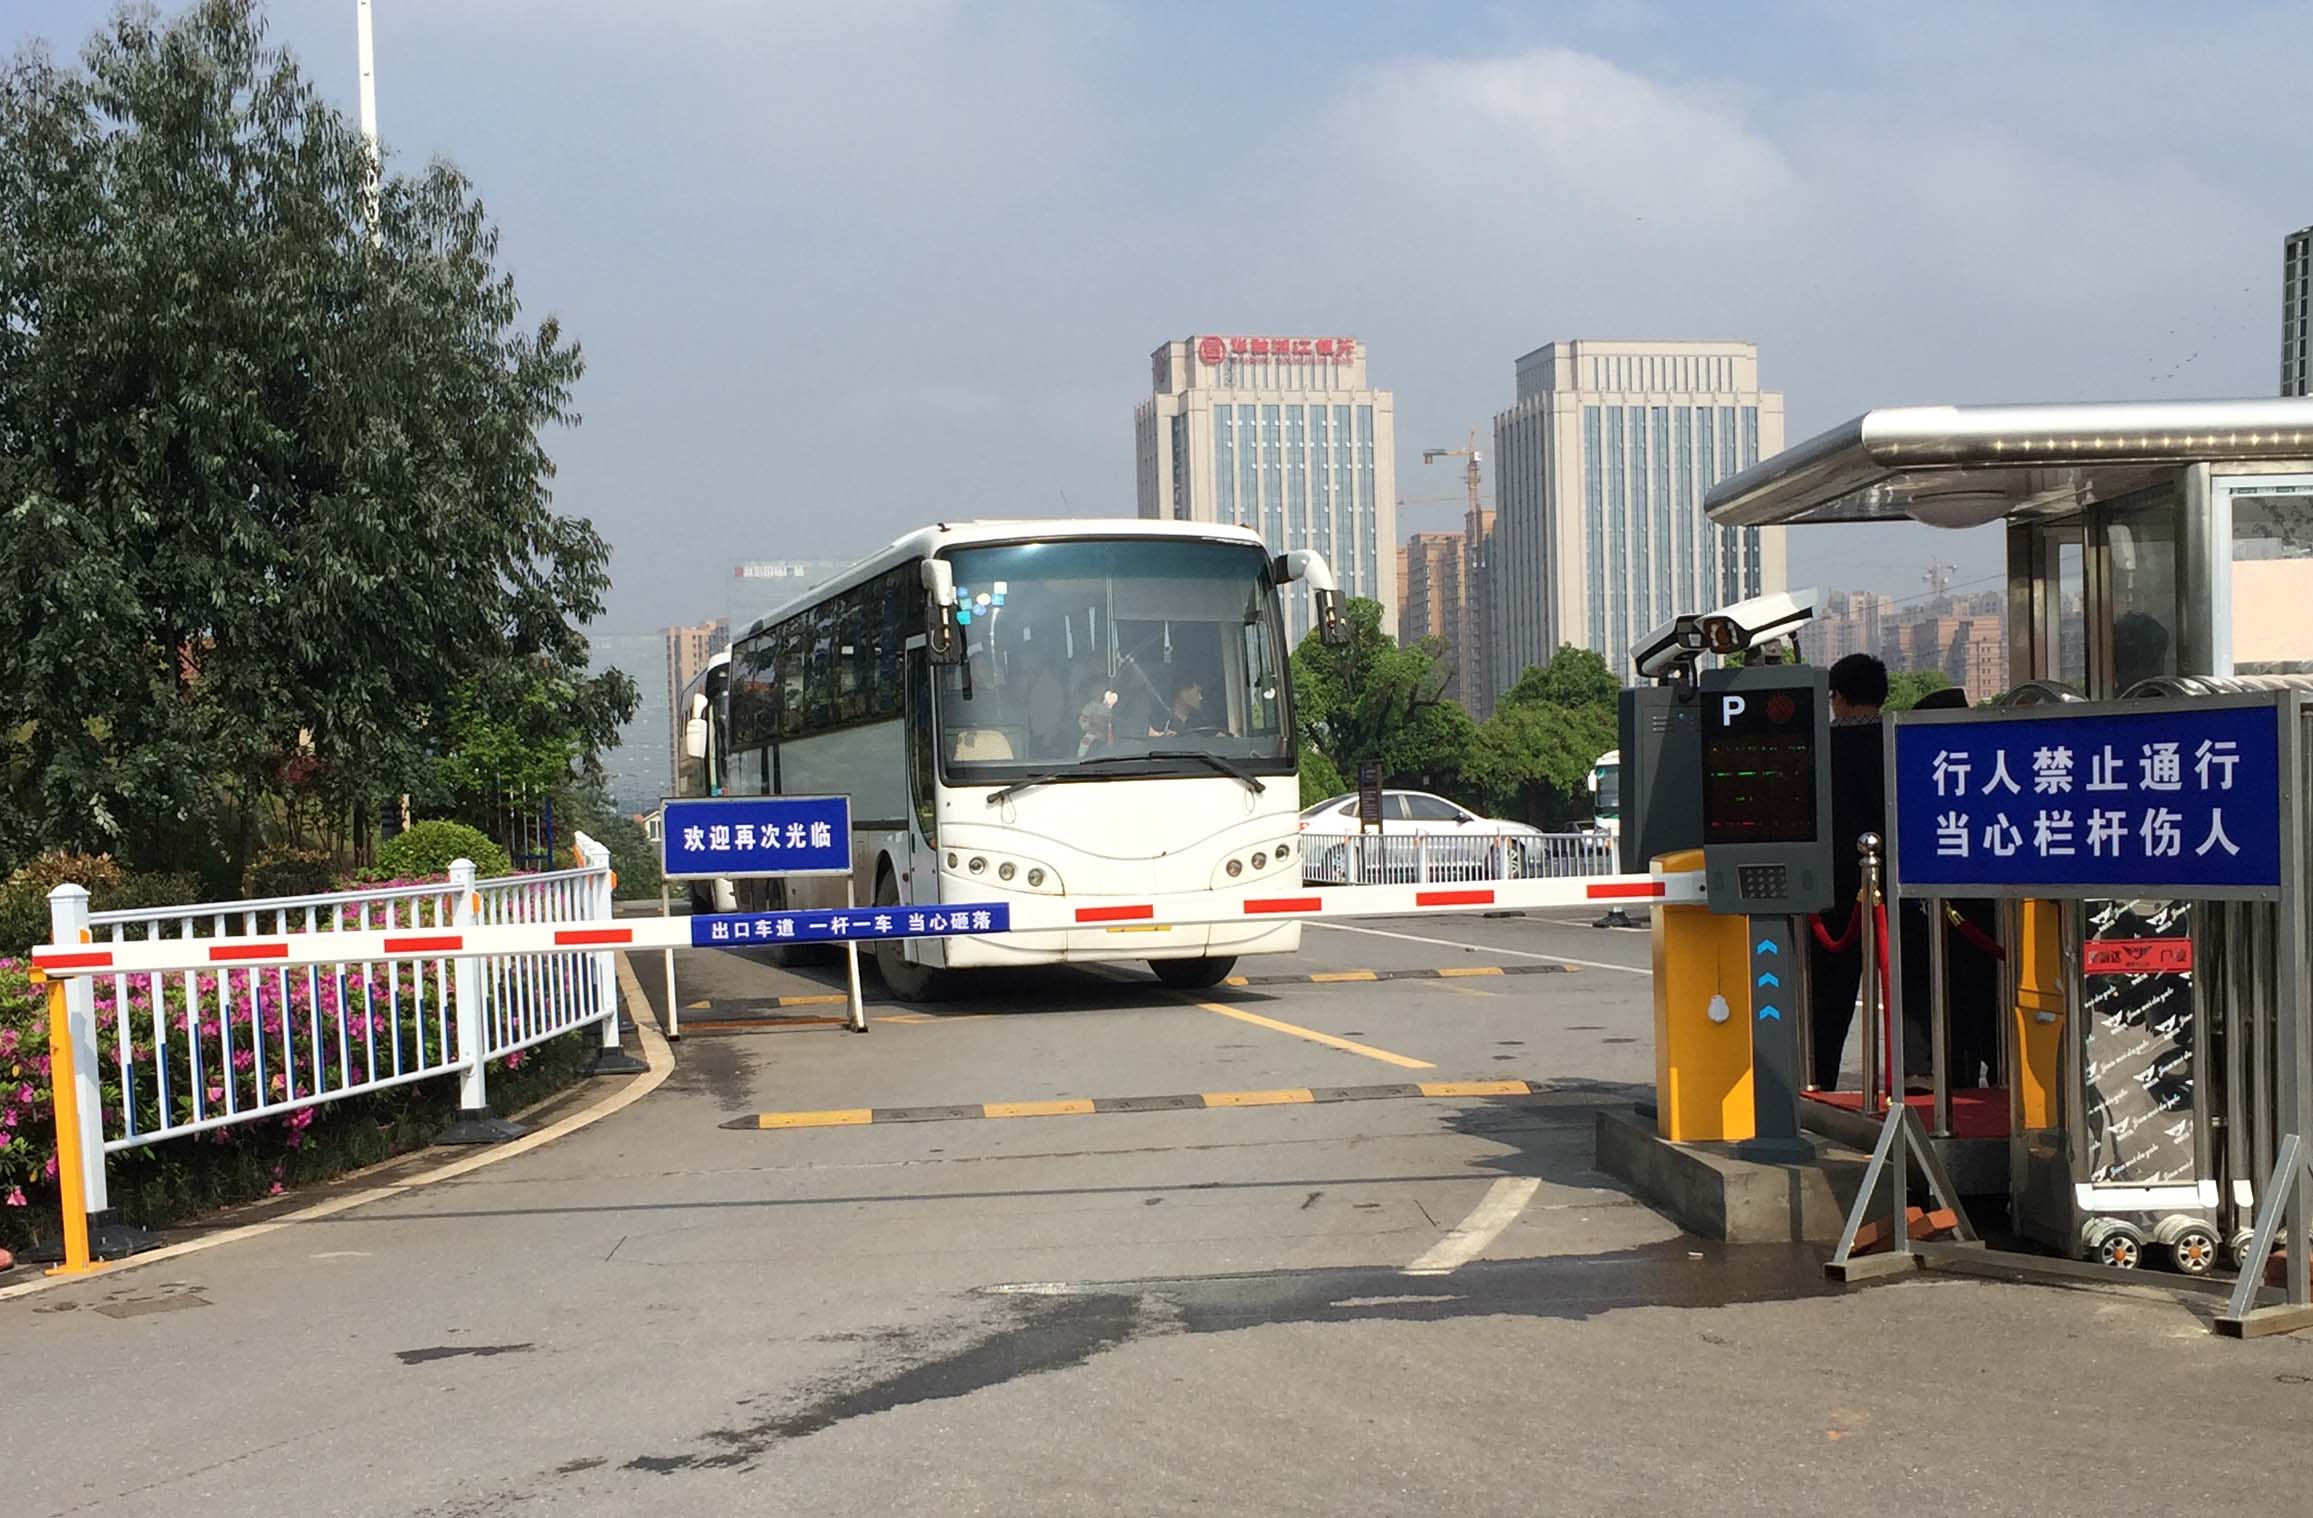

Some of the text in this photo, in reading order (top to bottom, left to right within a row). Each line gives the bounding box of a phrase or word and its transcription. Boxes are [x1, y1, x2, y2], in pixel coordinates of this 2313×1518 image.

[1722, 695, 1746, 726] P
[1932, 739, 2240, 796] 行人禁止通行
[683, 821, 832, 852] 欢迎再次光临
[1936, 807, 2240, 857] 当心栏杆伤人
[711, 910, 992, 940] 出口车道 一杆一车 当心砸落
